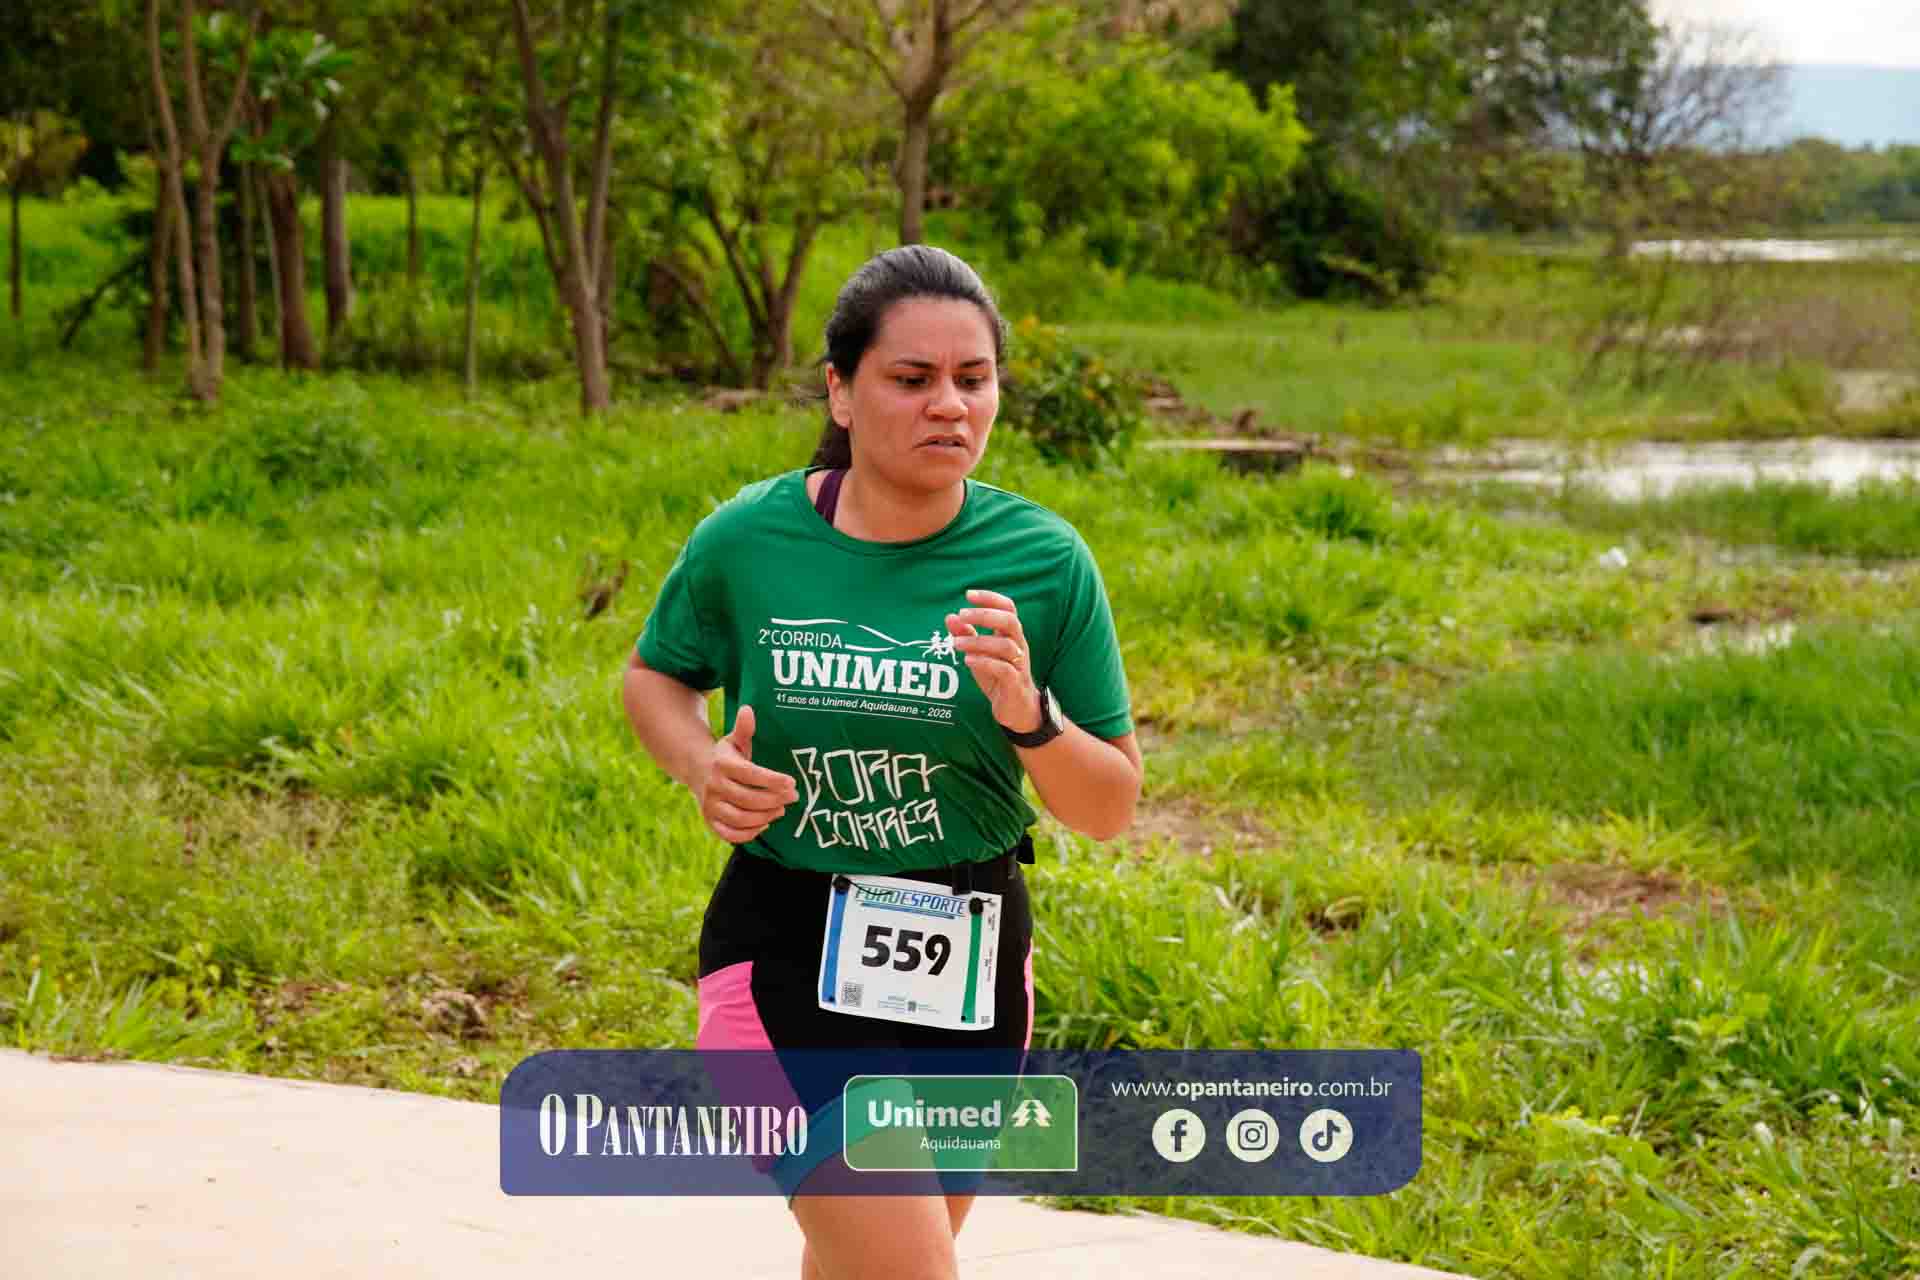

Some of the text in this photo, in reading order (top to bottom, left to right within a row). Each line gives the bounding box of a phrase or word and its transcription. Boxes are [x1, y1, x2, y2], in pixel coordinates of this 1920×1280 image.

[771, 629, 842, 648] CORRIDA
[771, 649, 960, 700] UNIMED
[776, 692, 786, 703] 41
[787, 695, 807, 705] anos
[822, 696, 859, 709] Unimed
[860, 699, 919, 715] Aquidauana
[928, 707, 952, 719] 2026
[791, 747, 948, 838] BORA
[810, 798, 945, 851] CORRER
[861, 924, 951, 976] 559
